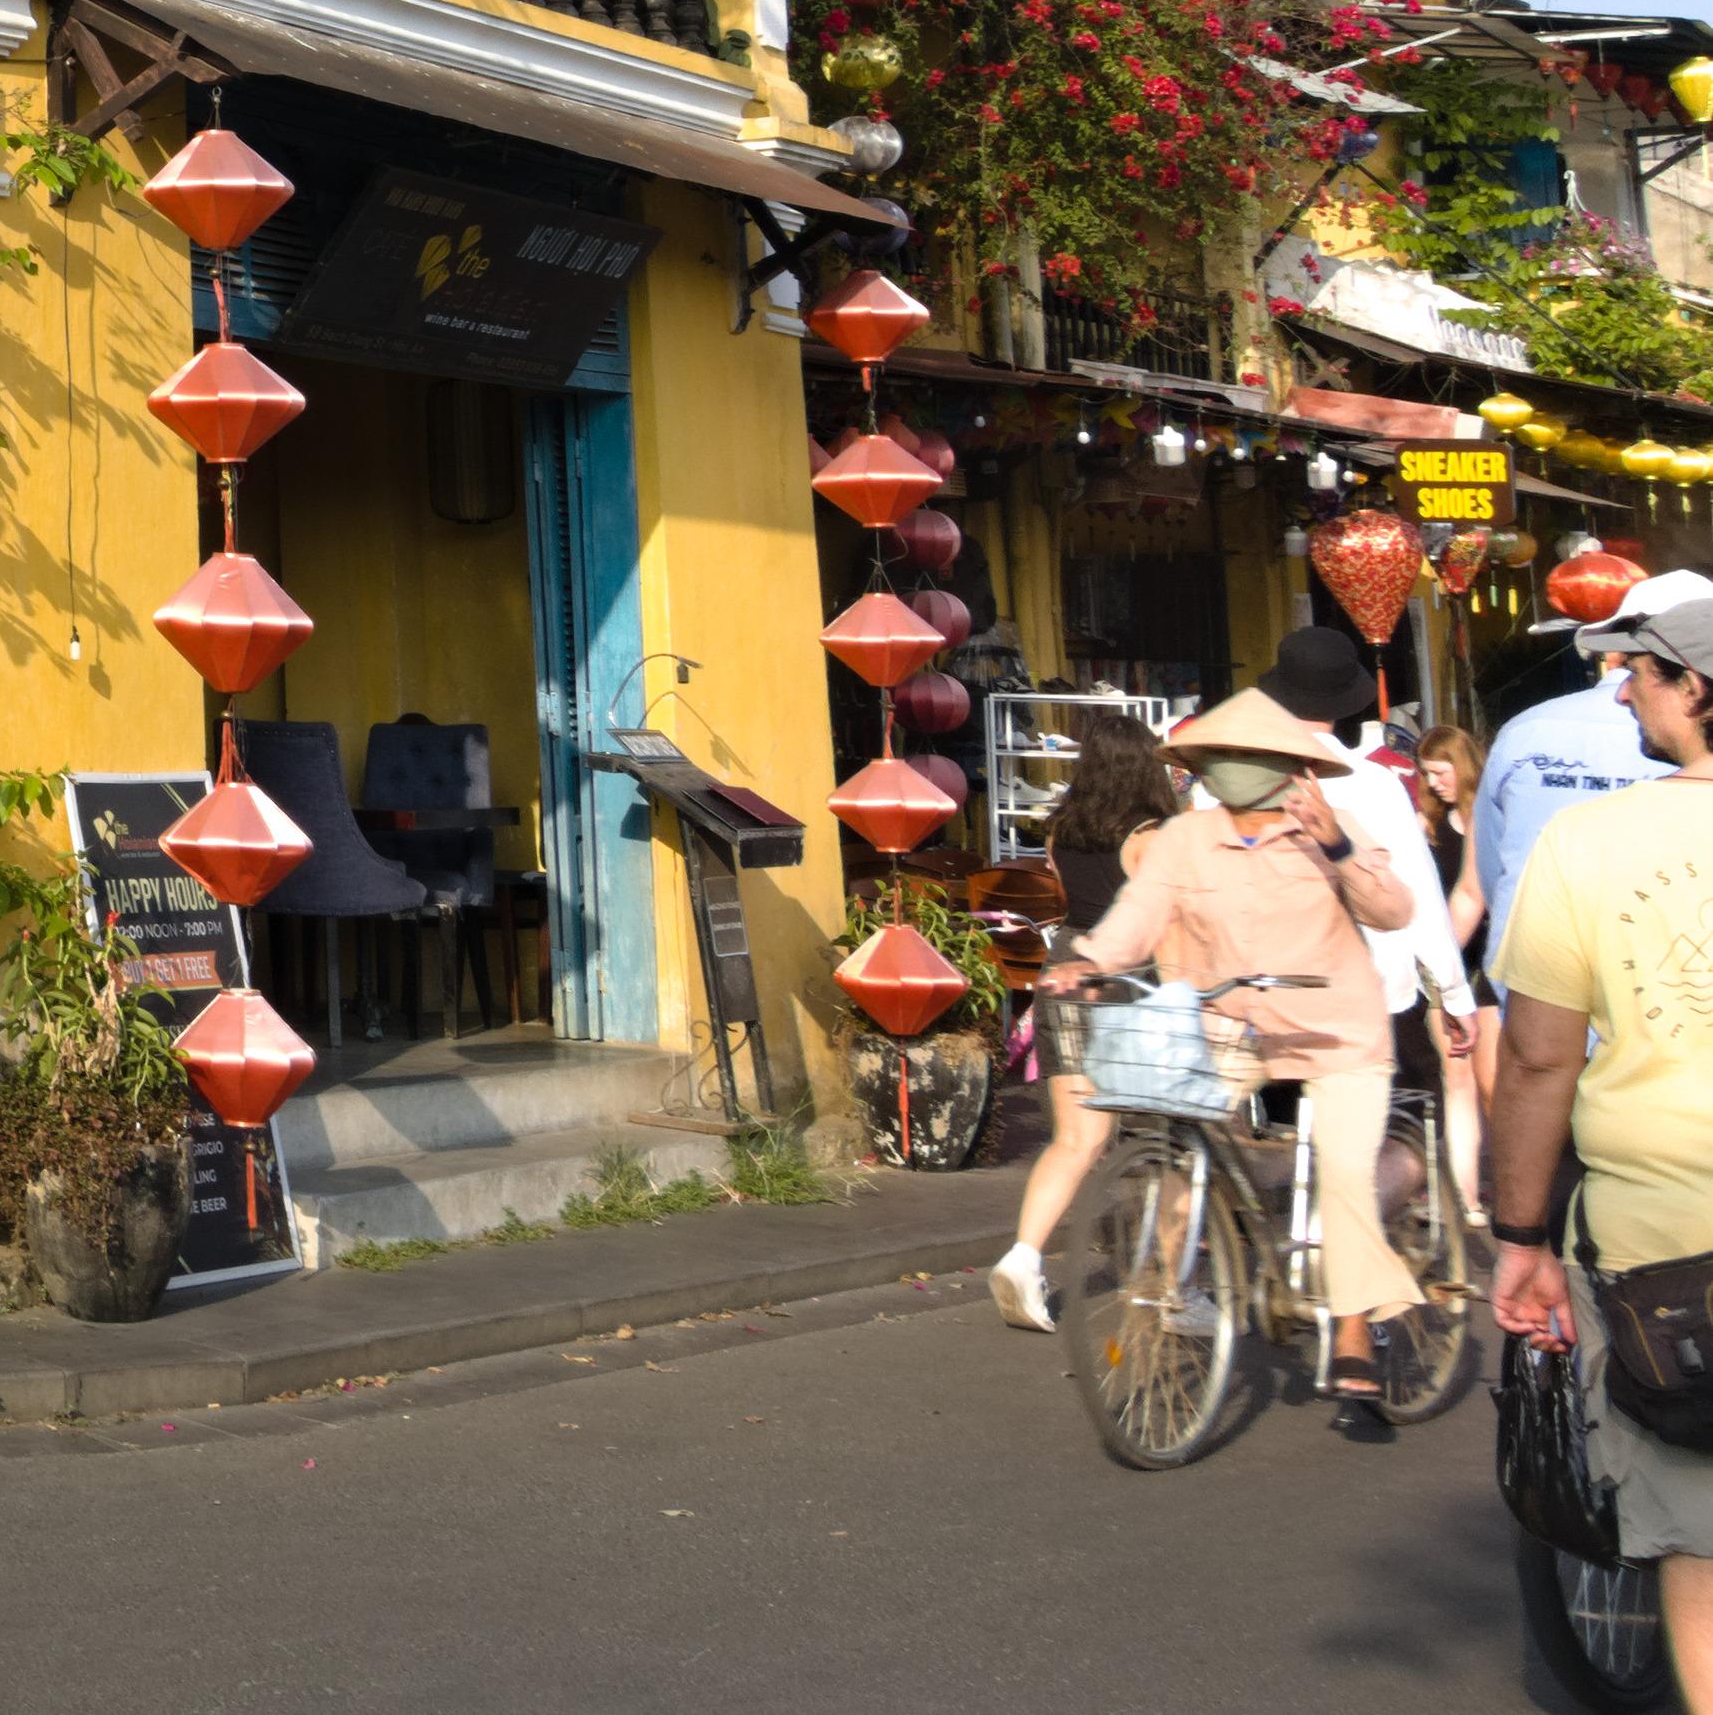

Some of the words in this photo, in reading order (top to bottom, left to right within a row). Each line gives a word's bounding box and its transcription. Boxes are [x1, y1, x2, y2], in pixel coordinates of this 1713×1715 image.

[456, 249, 492, 279] the
[424, 312, 449, 327] wine
[477, 321, 531, 341] restaurant
[1400, 449, 1508, 484] SNEAKER
[1417, 487, 1494, 521] SHOES
[105, 877, 163, 914] HAPPY
[145, 923, 177, 938] NOON
[185, 921, 206, 937] 7:00
[207, 921, 223, 935] PM
[184, 955, 212, 982] FREE
[200, 1196, 227, 1213] BEER
